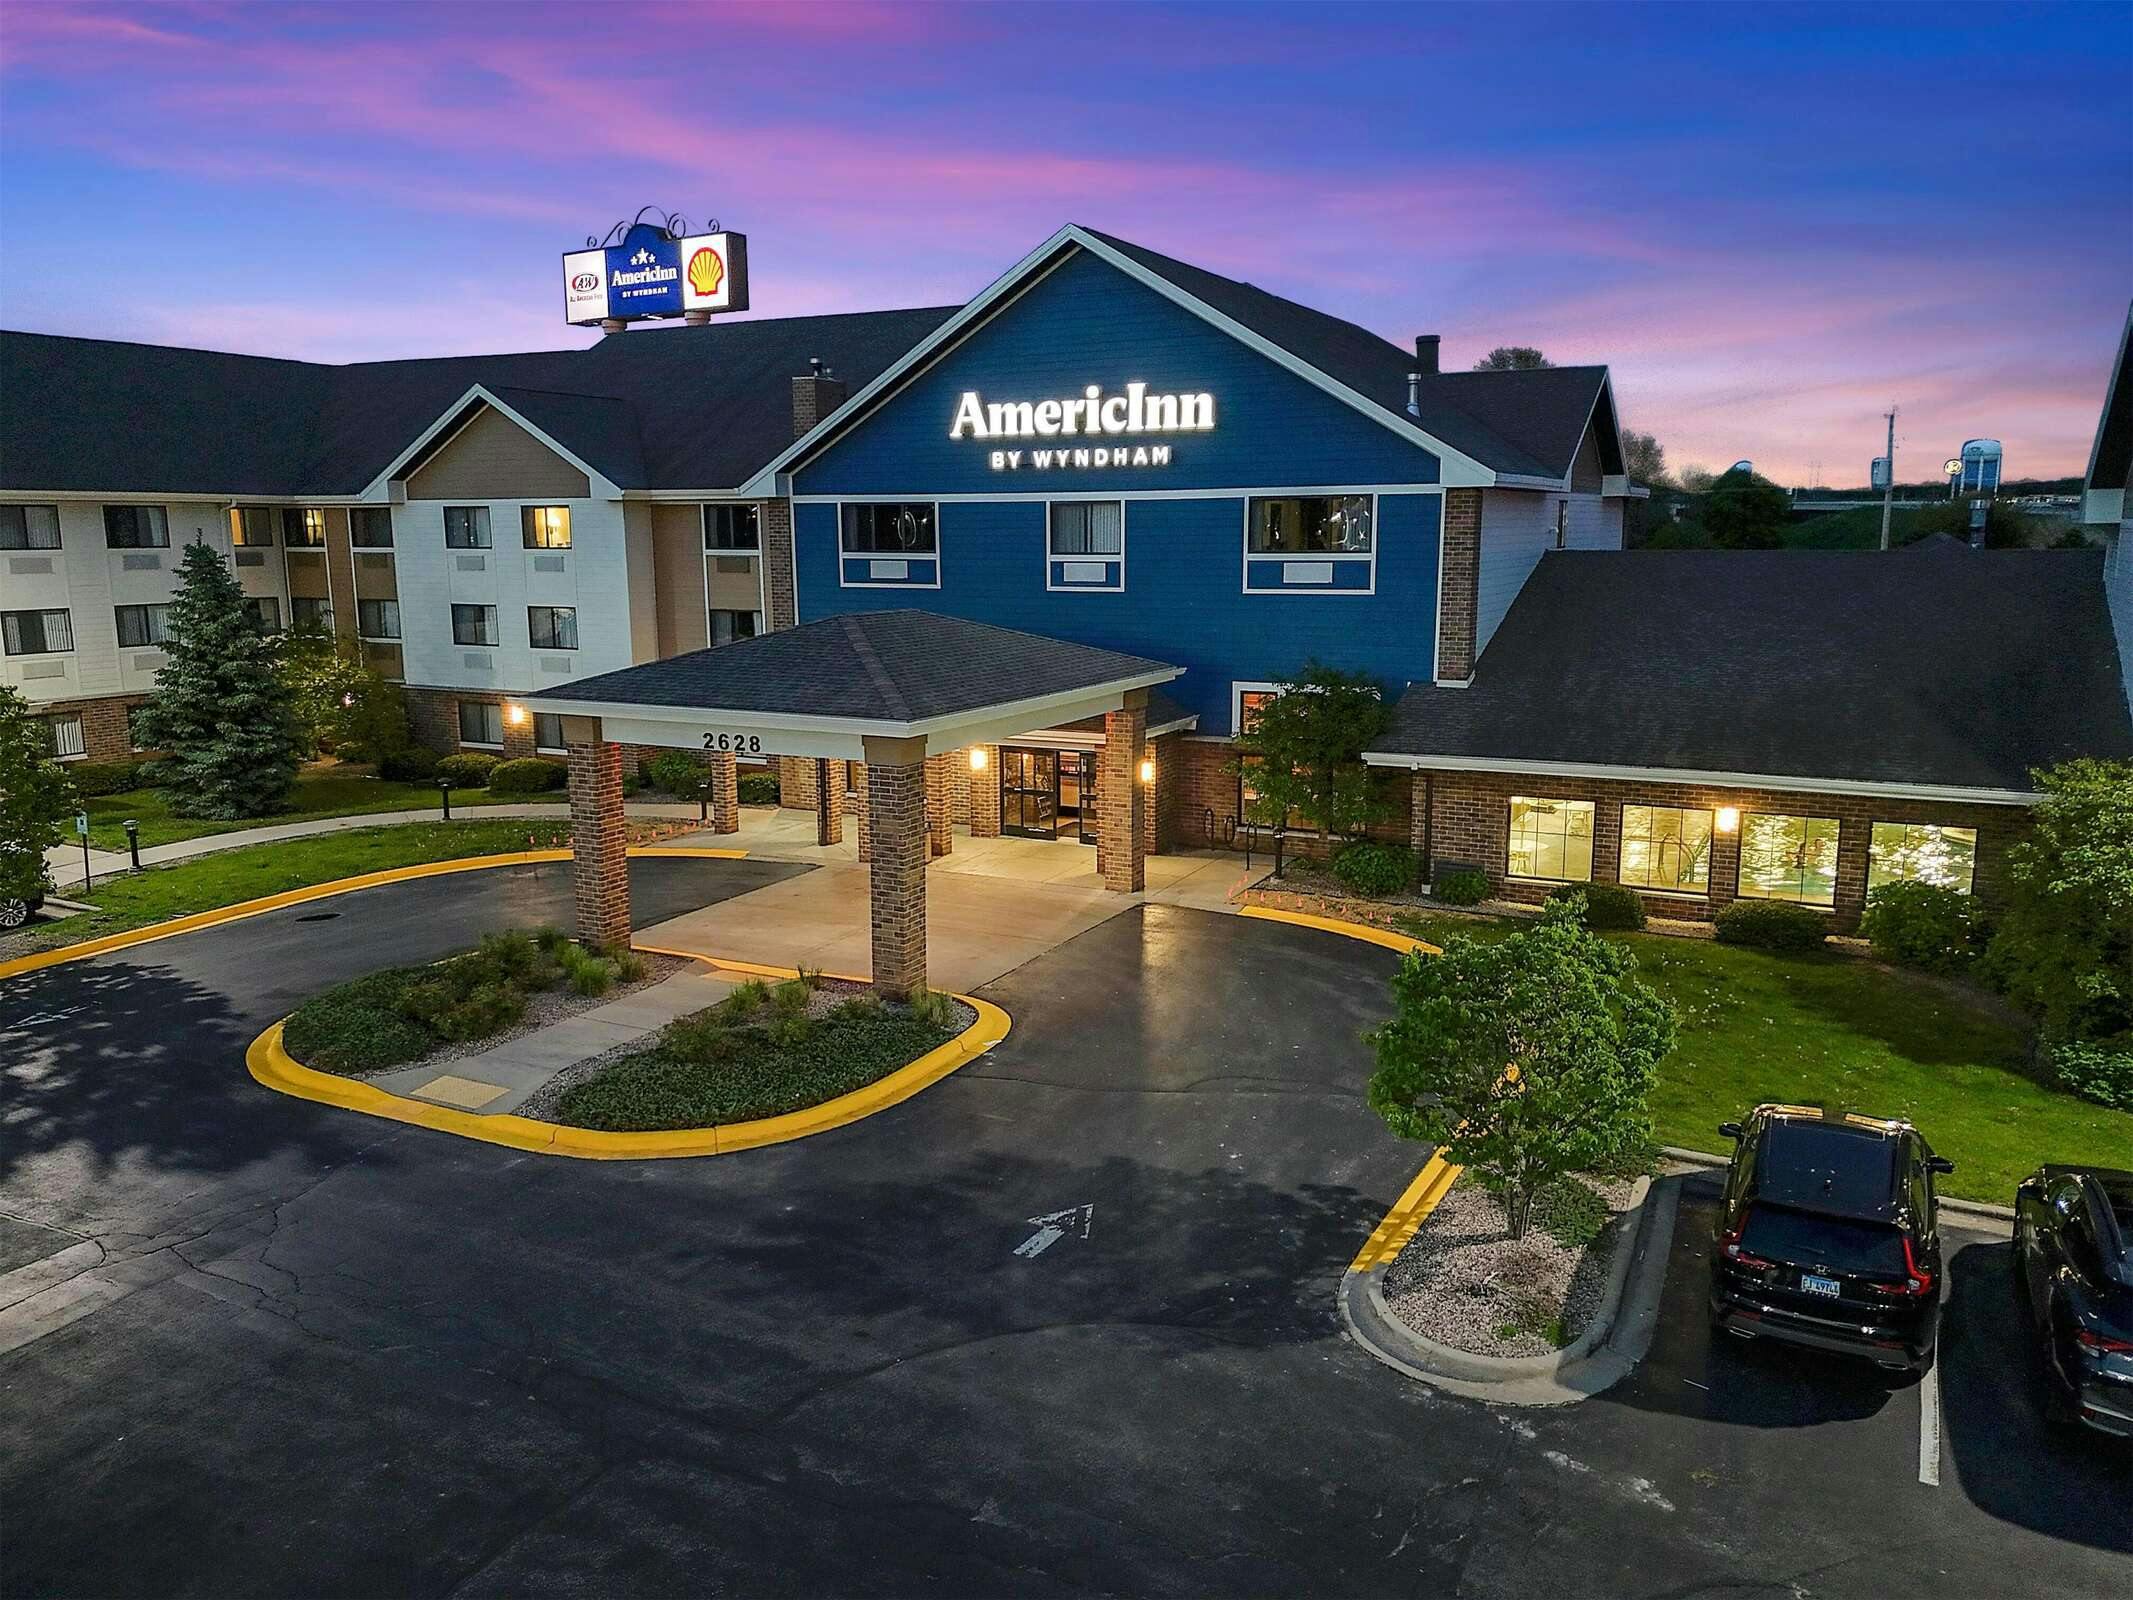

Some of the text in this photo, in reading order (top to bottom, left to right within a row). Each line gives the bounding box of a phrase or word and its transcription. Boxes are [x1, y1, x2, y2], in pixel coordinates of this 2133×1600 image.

[612, 265, 677, 286] AmericInn
[622, 287, 668, 298] BY WYNDHAM
[949, 382, 1215, 440] AmericInn
[991, 446, 1171, 470] BY WYNDHAM
[702, 732, 761, 752] 2628
